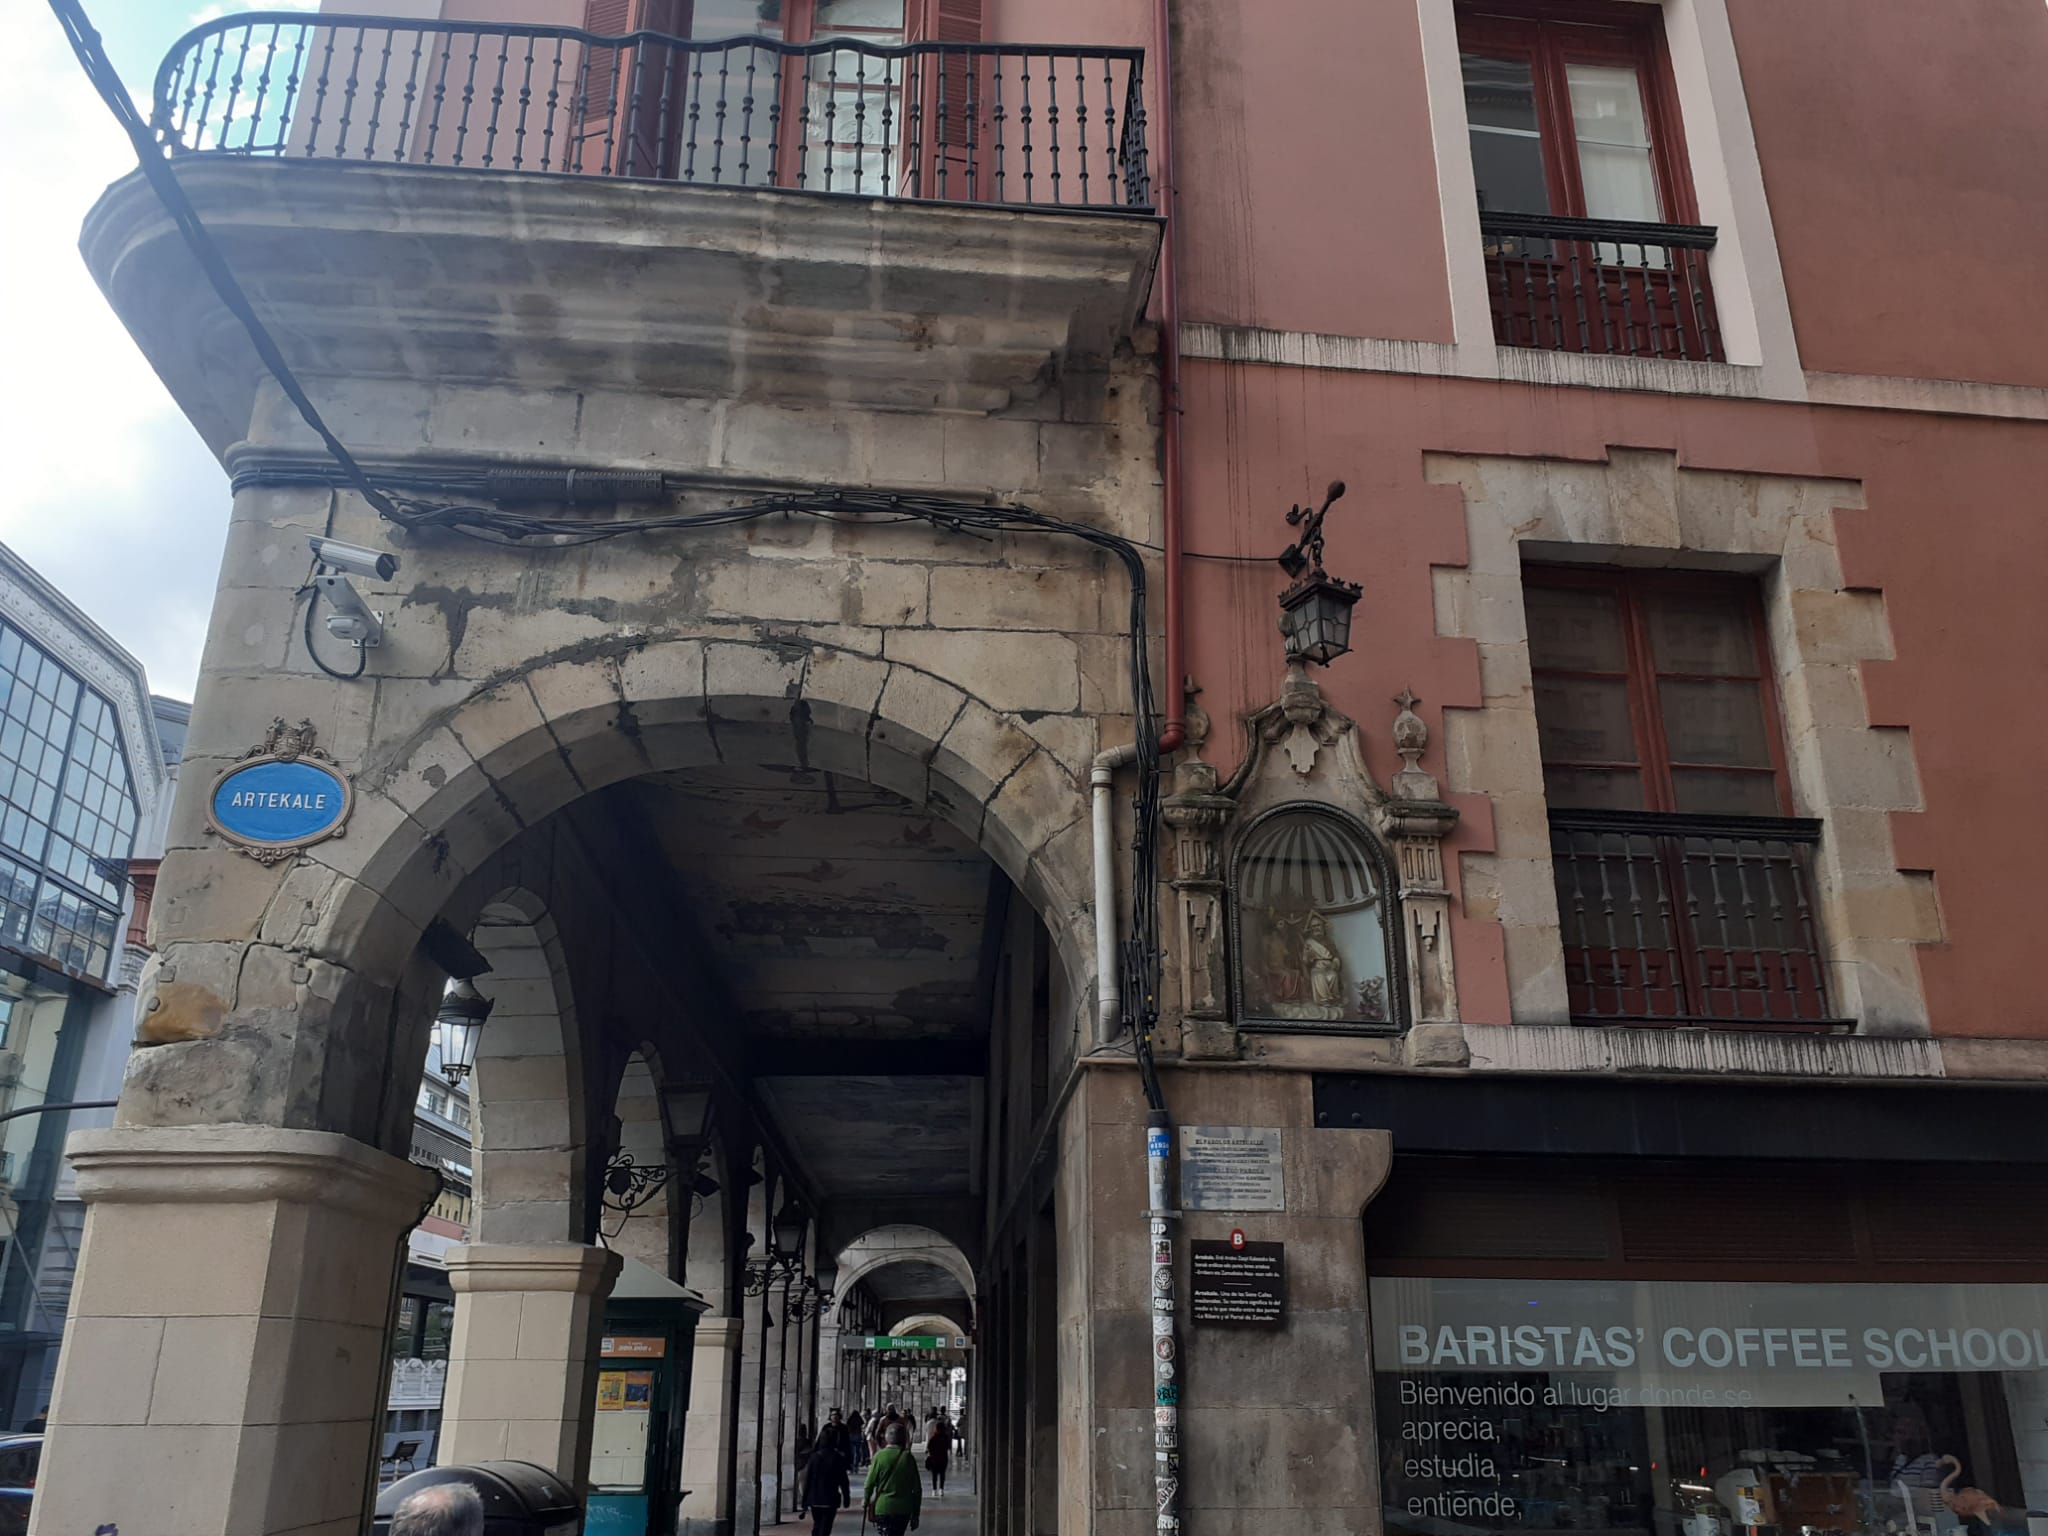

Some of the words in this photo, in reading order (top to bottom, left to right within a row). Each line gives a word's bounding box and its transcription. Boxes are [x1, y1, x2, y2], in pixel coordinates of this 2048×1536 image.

[231, 791, 326, 809] ARTEKALE
[1233, 1233, 1243, 1245] B
[891, 1338, 920, 1348] Ribera
[1662, 1327, 1854, 1368] COFFEE
[1863, 1327, 2048, 1369] SCHOOL
[1400, 1380, 1535, 1406] Bienvenido
[1543, 1381, 1563, 1406] al
[1571, 1382, 1631, 1412] lugar
[1638, 1383, 1716, 1407] donde
[1723, 1389, 1752, 1407] se
[1401, 1415, 1501, 1445] aprecia,
[1404, 1452, 1501, 1482] estudia,
[1407, 1491, 1523, 1521] entiende,
